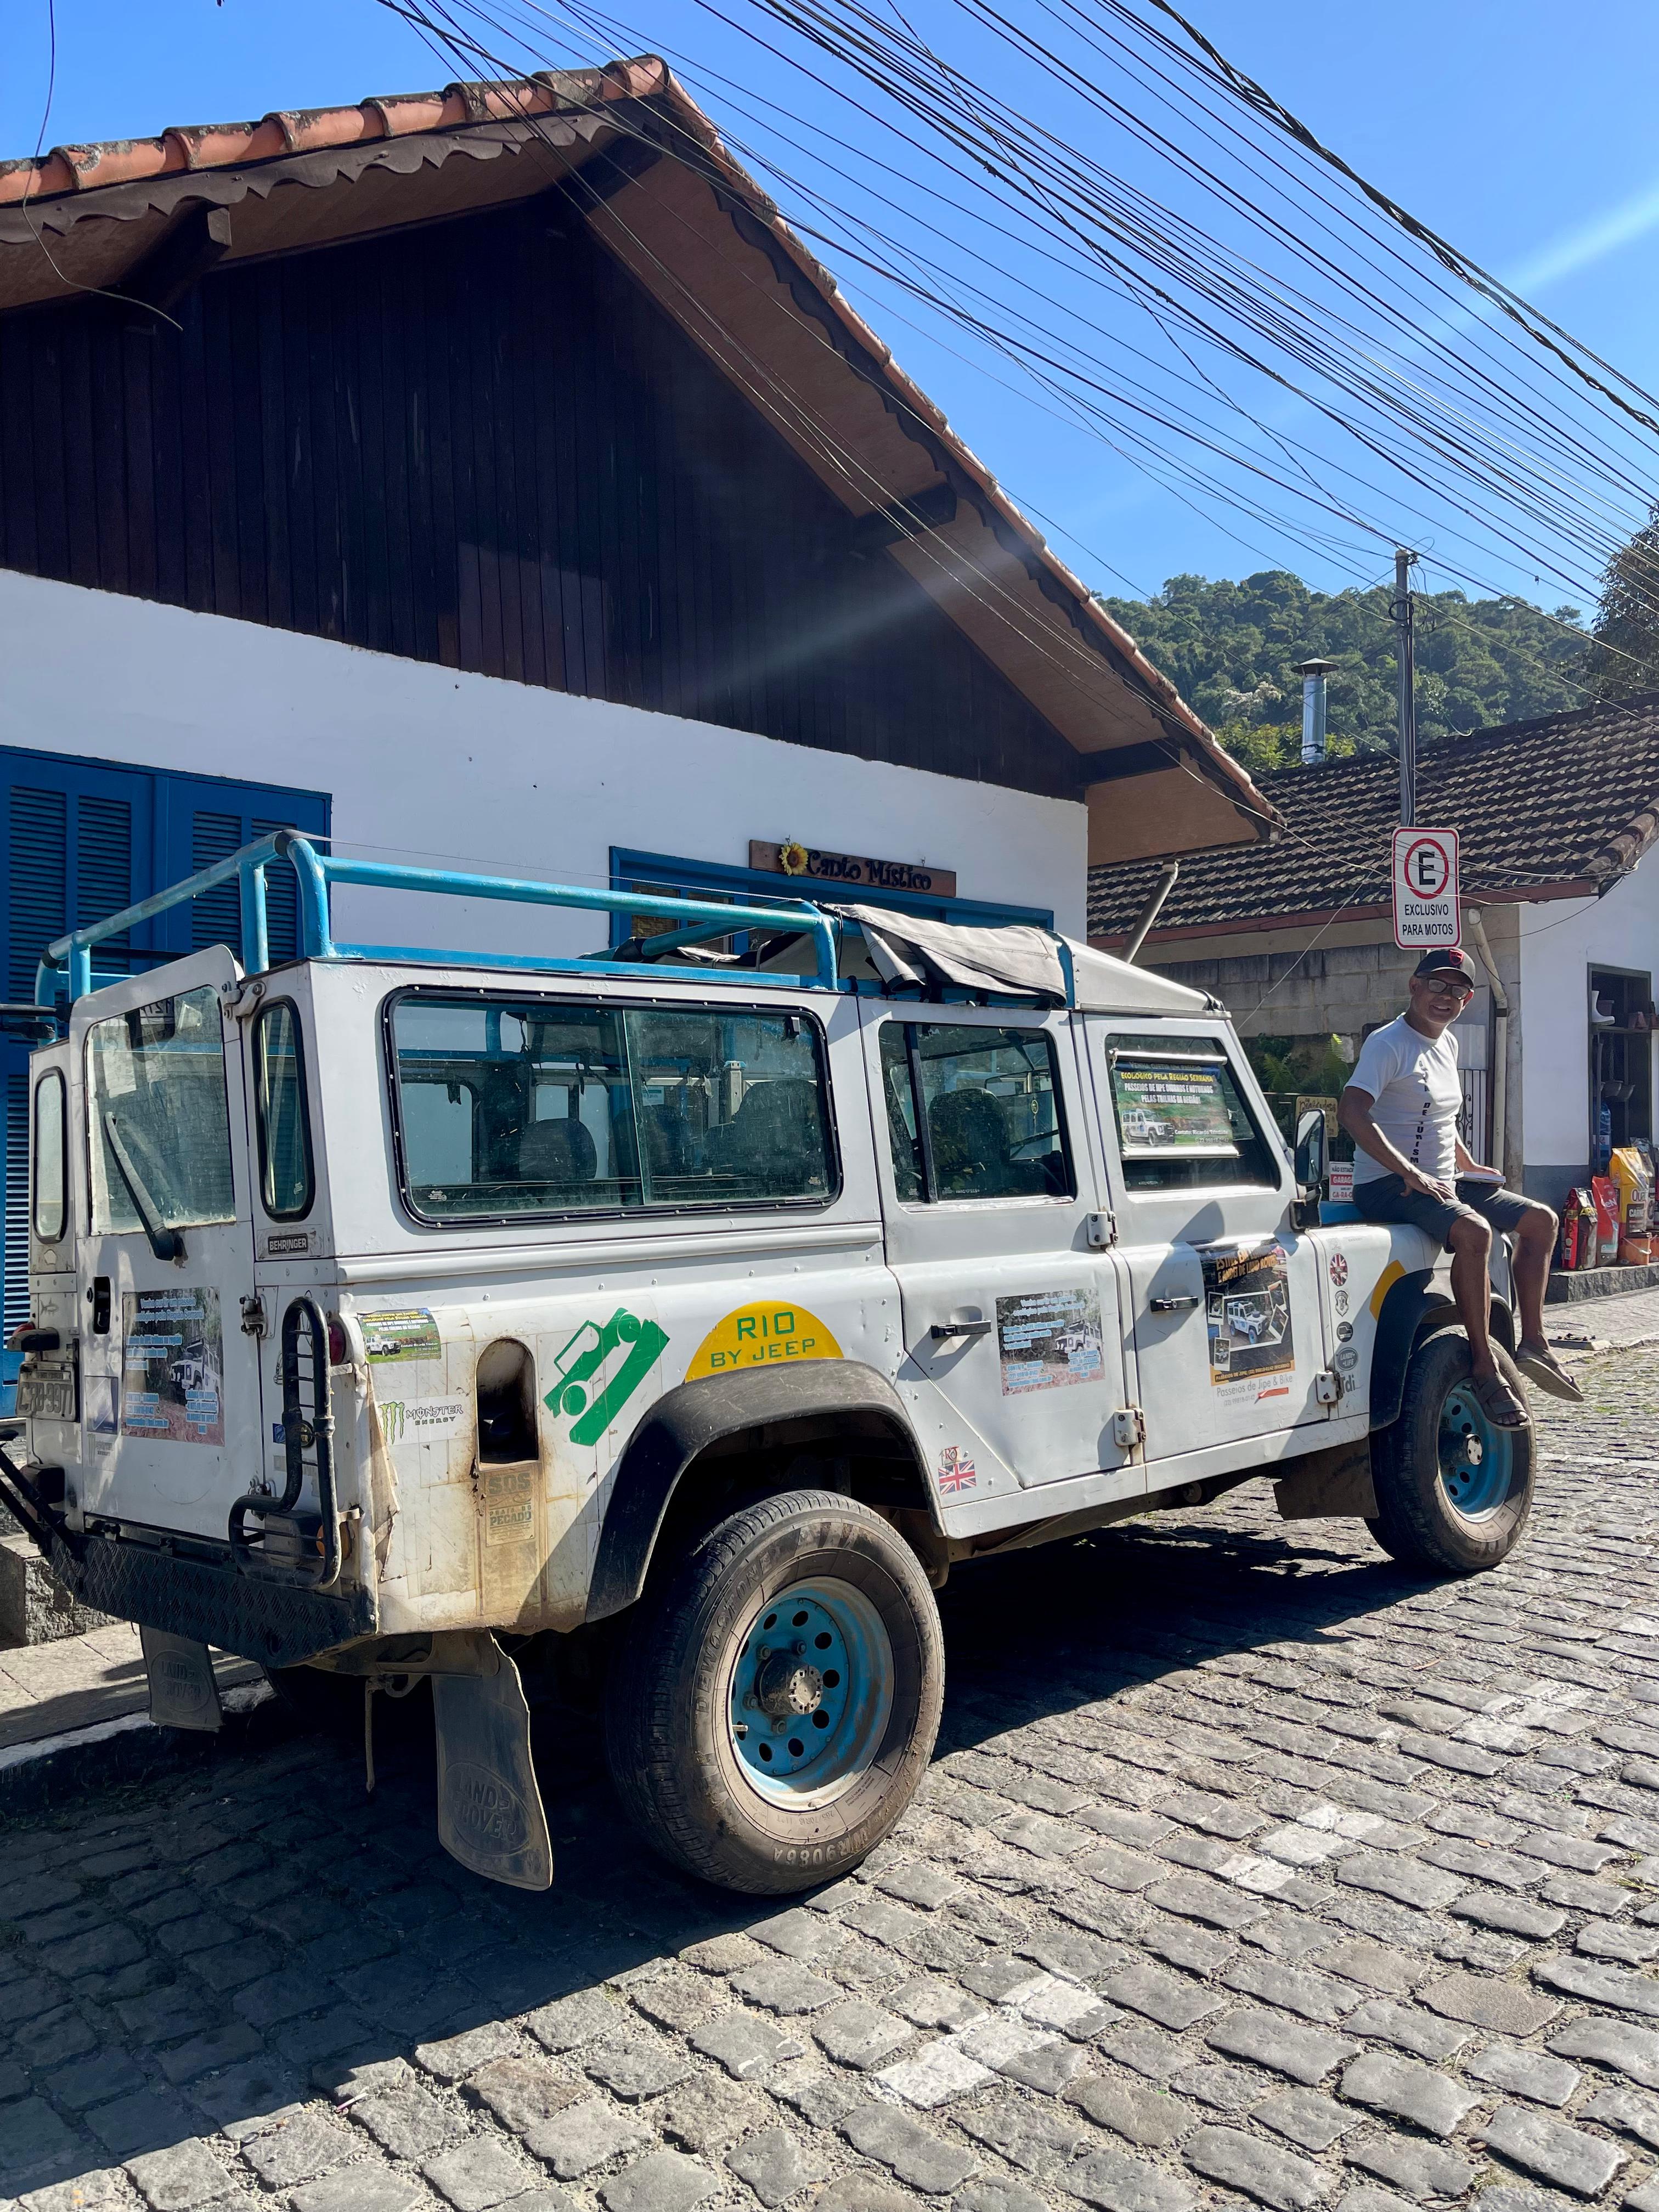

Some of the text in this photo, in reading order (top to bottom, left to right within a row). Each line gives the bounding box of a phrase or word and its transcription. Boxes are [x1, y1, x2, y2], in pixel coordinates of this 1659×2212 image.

[806, 850, 932, 890] Canto Místico
[1418, 851, 1436, 885] E
[1404, 904, 1449, 916] EXCLUSIVO
[1402, 923, 1453, 935] PARA MOTOS
[269, 1238, 307, 1251] BEHRINGER
[737, 1311, 795, 1341] RIO
[711, 1338, 815, 1368] BY JEEP
[1217, 1373, 1293, 1397] Passeios de Jipe & Bike
[406, 1404, 464, 1420] MONSTER
[415, 1416, 456, 1426] ENERGY
[489, 1471, 531, 1494] SOS
[490, 1511, 532, 1526] PECADO
